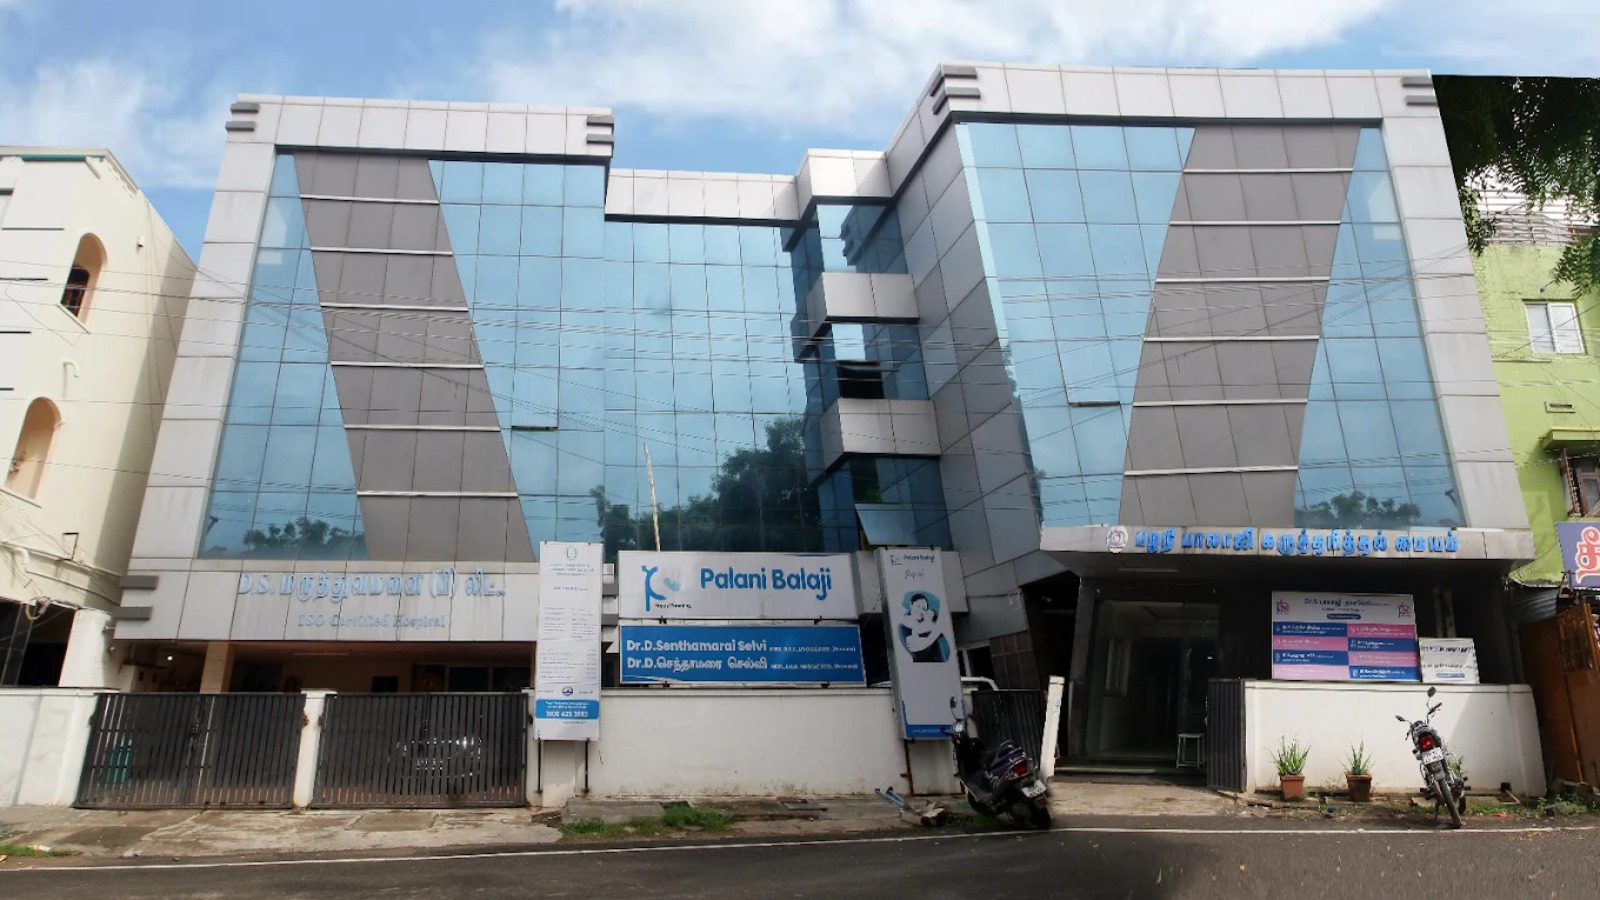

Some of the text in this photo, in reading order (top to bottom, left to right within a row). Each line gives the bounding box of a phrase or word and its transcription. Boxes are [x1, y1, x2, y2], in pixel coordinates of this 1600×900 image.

[1182, 527, 1255, 550] பாலாஜி
[1261, 528, 1388, 556] கருத்தரித்தல்
[1396, 529, 1459, 552] மையம்
[237, 573, 274, 595] D.S.
[700, 567, 832, 601] Palani Balaji
[297, 613, 446, 629] ISO Certified Hospital
[738, 639, 767, 652] Selvi
[727, 656, 767, 669] செல்வி
